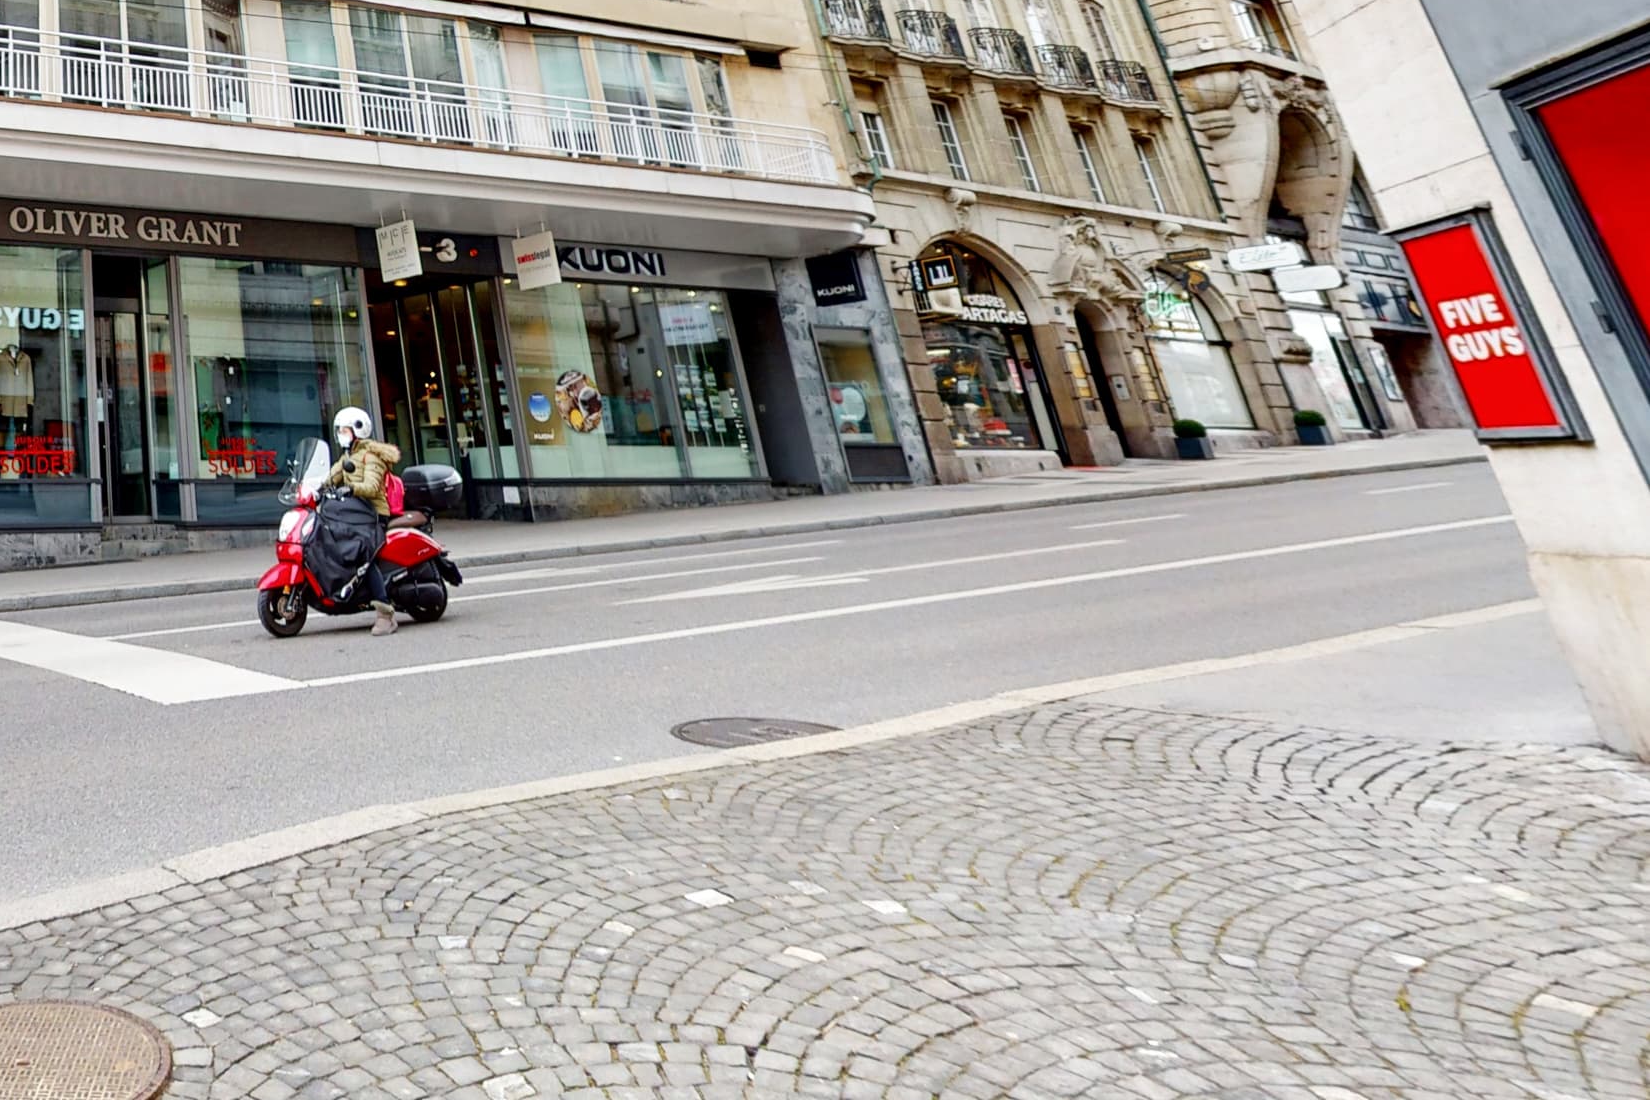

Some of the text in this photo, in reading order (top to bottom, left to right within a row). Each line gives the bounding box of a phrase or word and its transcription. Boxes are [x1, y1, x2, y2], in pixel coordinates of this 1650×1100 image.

[9, 206, 242, 247] OLIVER GRANT
[517, 248, 551, 264] swisslegal
[556, 246, 666, 277] KUONI
[816, 283, 855, 297] KUONI
[962, 305, 1028, 325] ARTAGAS
[1438, 293, 1504, 329] FIVE
[1446, 326, 1525, 362] GUYS
[0, 456, 74, 475] SOLDES
[208, 454, 278, 475] SOLDES
